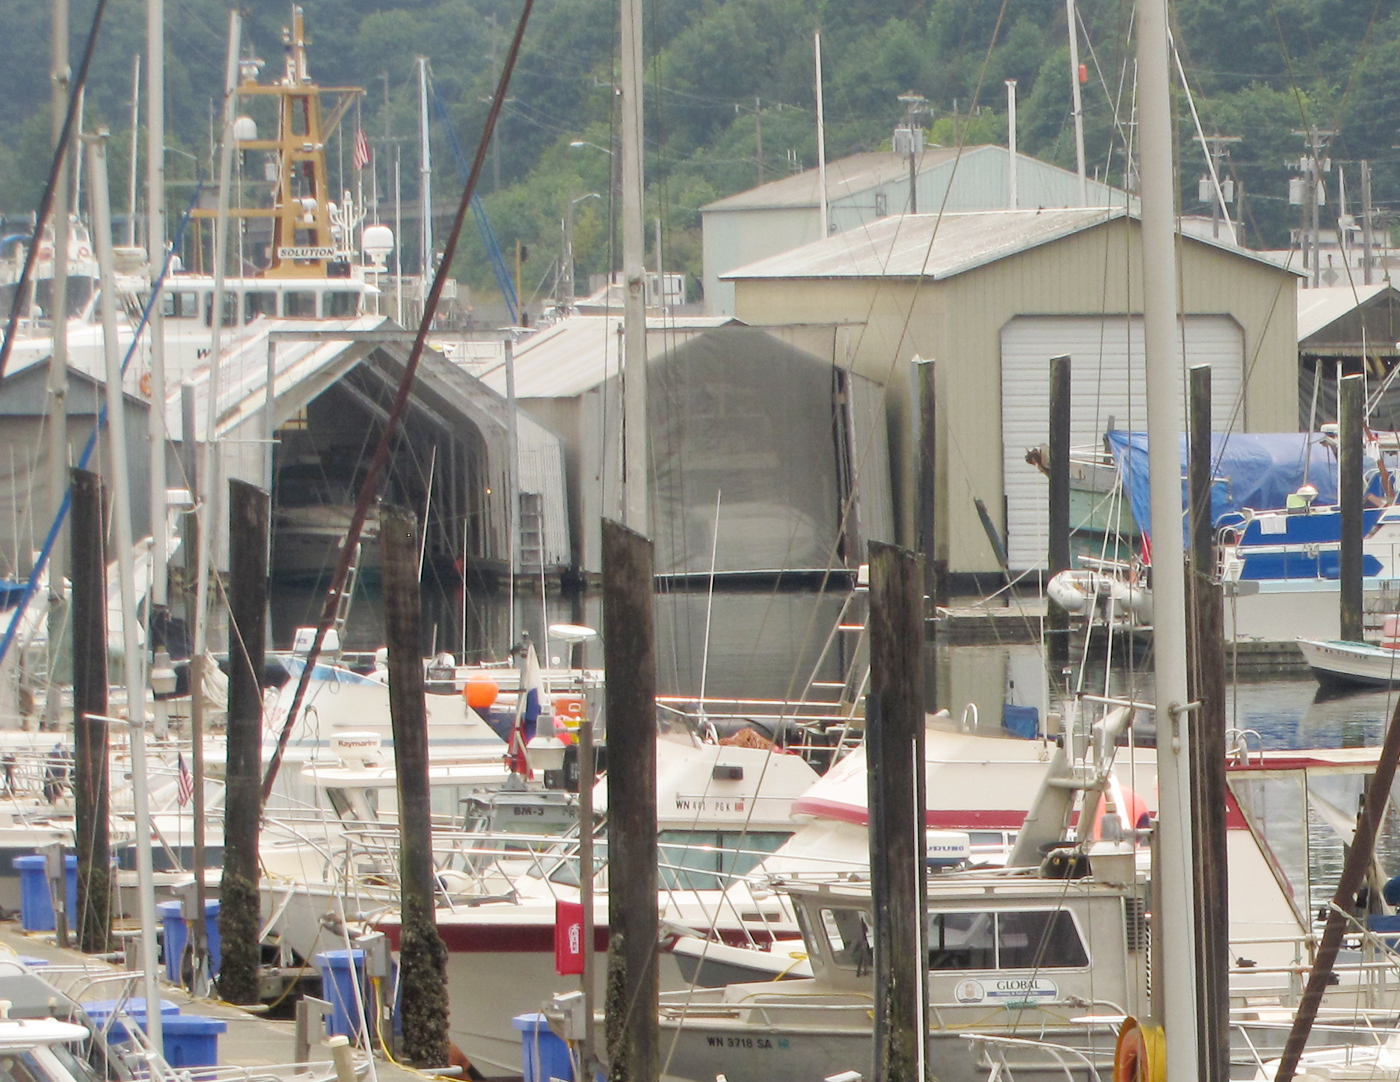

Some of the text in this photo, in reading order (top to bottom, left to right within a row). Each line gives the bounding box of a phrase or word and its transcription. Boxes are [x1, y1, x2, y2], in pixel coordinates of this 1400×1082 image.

[280, 248, 335, 257] SOLUTION
[338, 740, 378, 748] Raymarine
[513, 806, 545, 816] BM-3
[996, 980, 1040, 991] GLOBAL
[706, 1036, 773, 1049] WN 3718 SA
